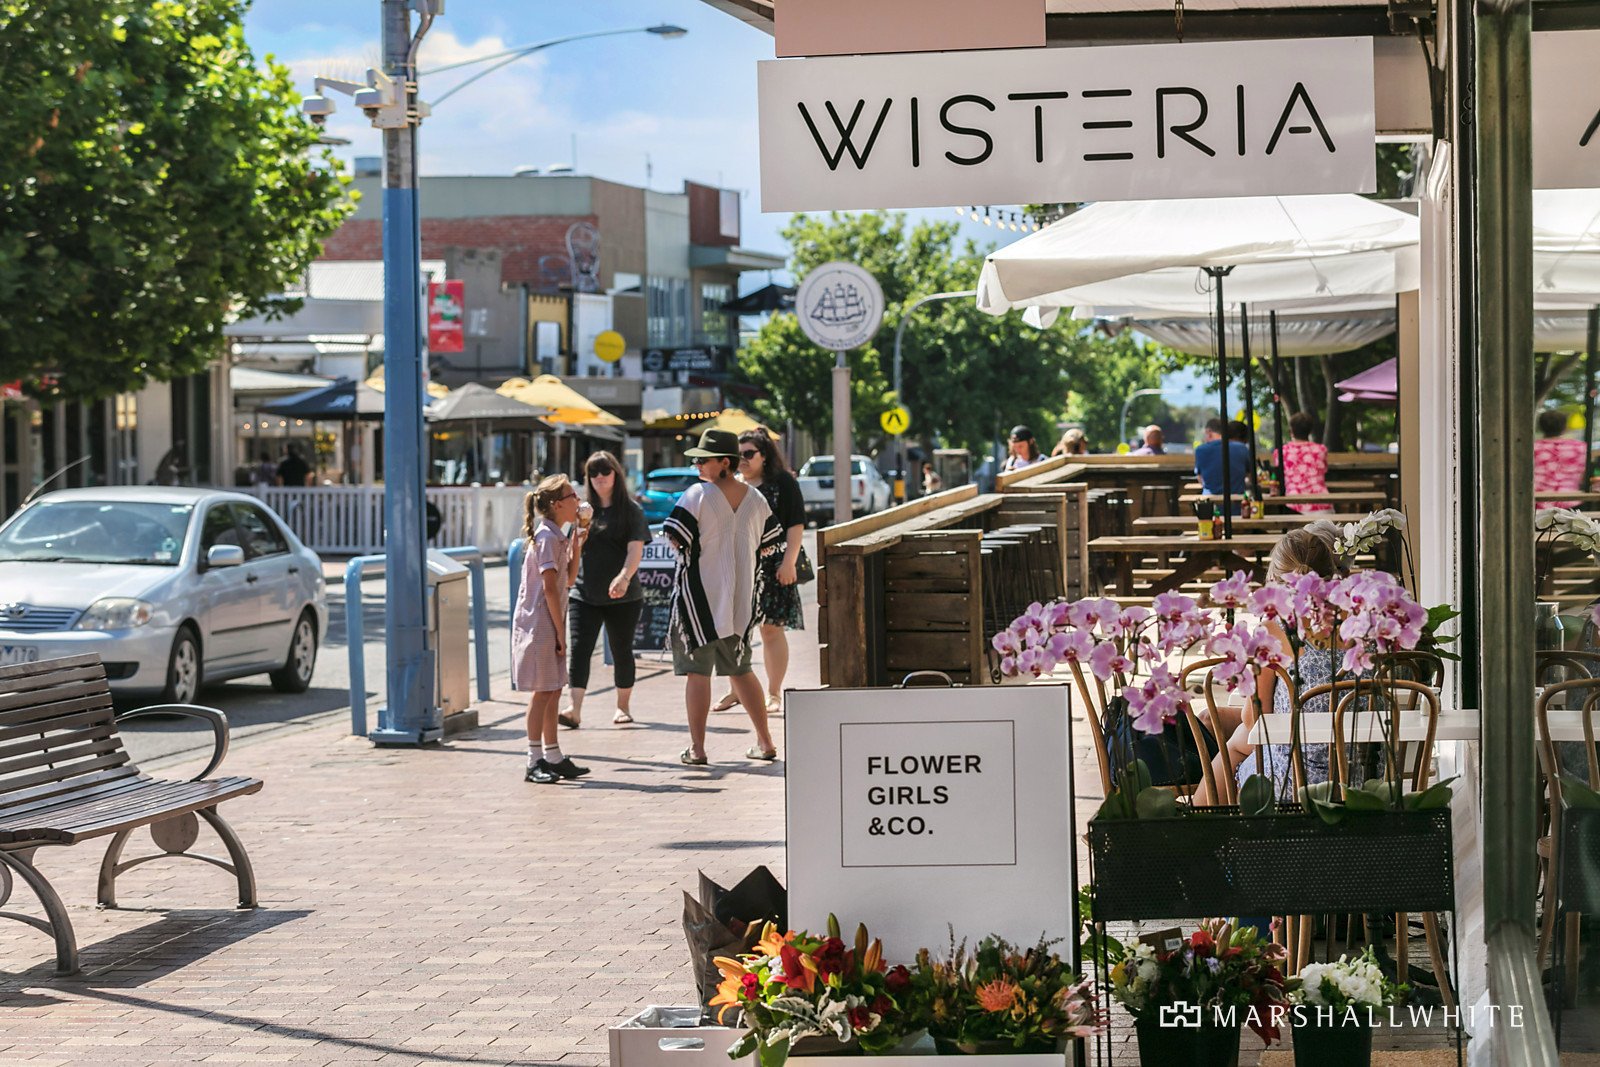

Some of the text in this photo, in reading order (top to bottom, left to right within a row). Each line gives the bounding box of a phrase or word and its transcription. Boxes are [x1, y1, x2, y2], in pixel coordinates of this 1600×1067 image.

[798, 82, 1336, 171] WISTERIA
[867, 754, 982, 775] FLOWER
[867, 785, 949, 805] GIRLS
[868, 816, 934, 836] &CO.
